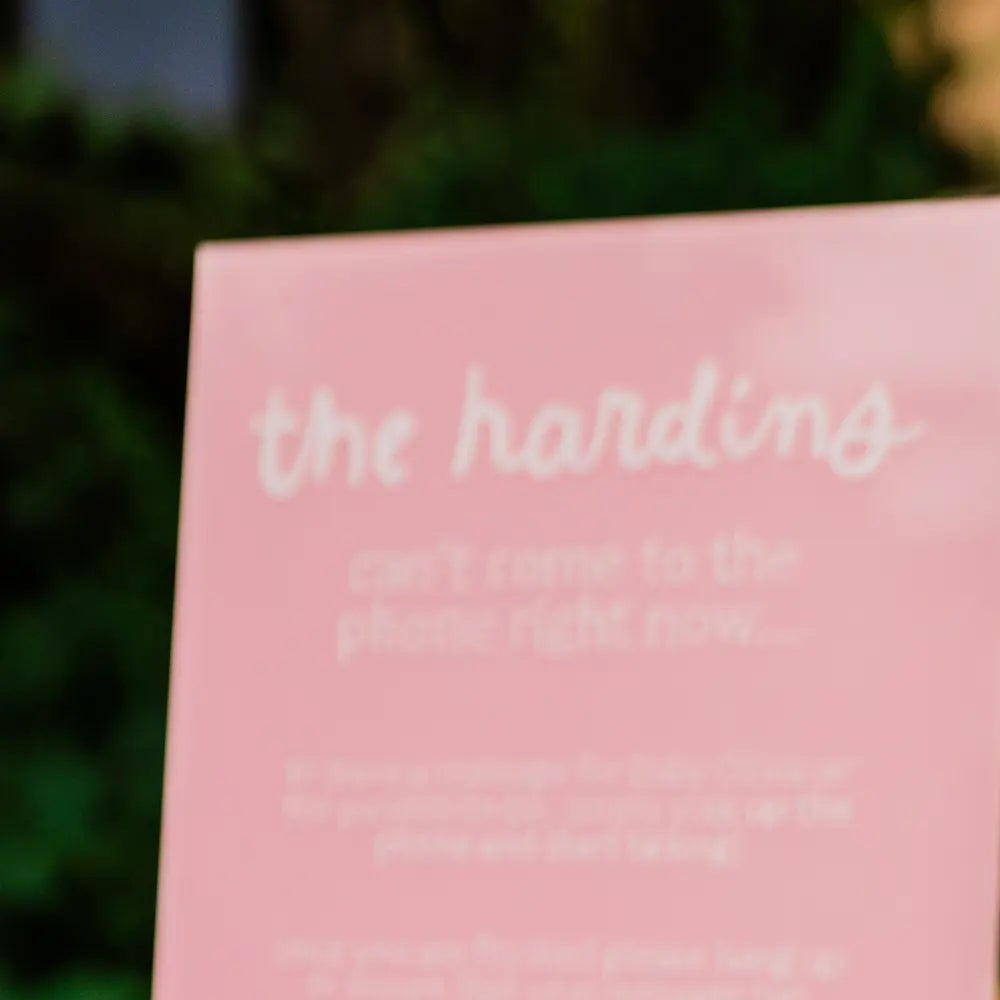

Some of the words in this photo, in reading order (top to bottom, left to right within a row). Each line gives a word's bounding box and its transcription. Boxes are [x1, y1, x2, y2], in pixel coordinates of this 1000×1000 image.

[250, 383, 418, 500] the
[641, 534, 699, 588] to
[709, 525, 803, 586] the
[336, 598, 497, 667] phone
